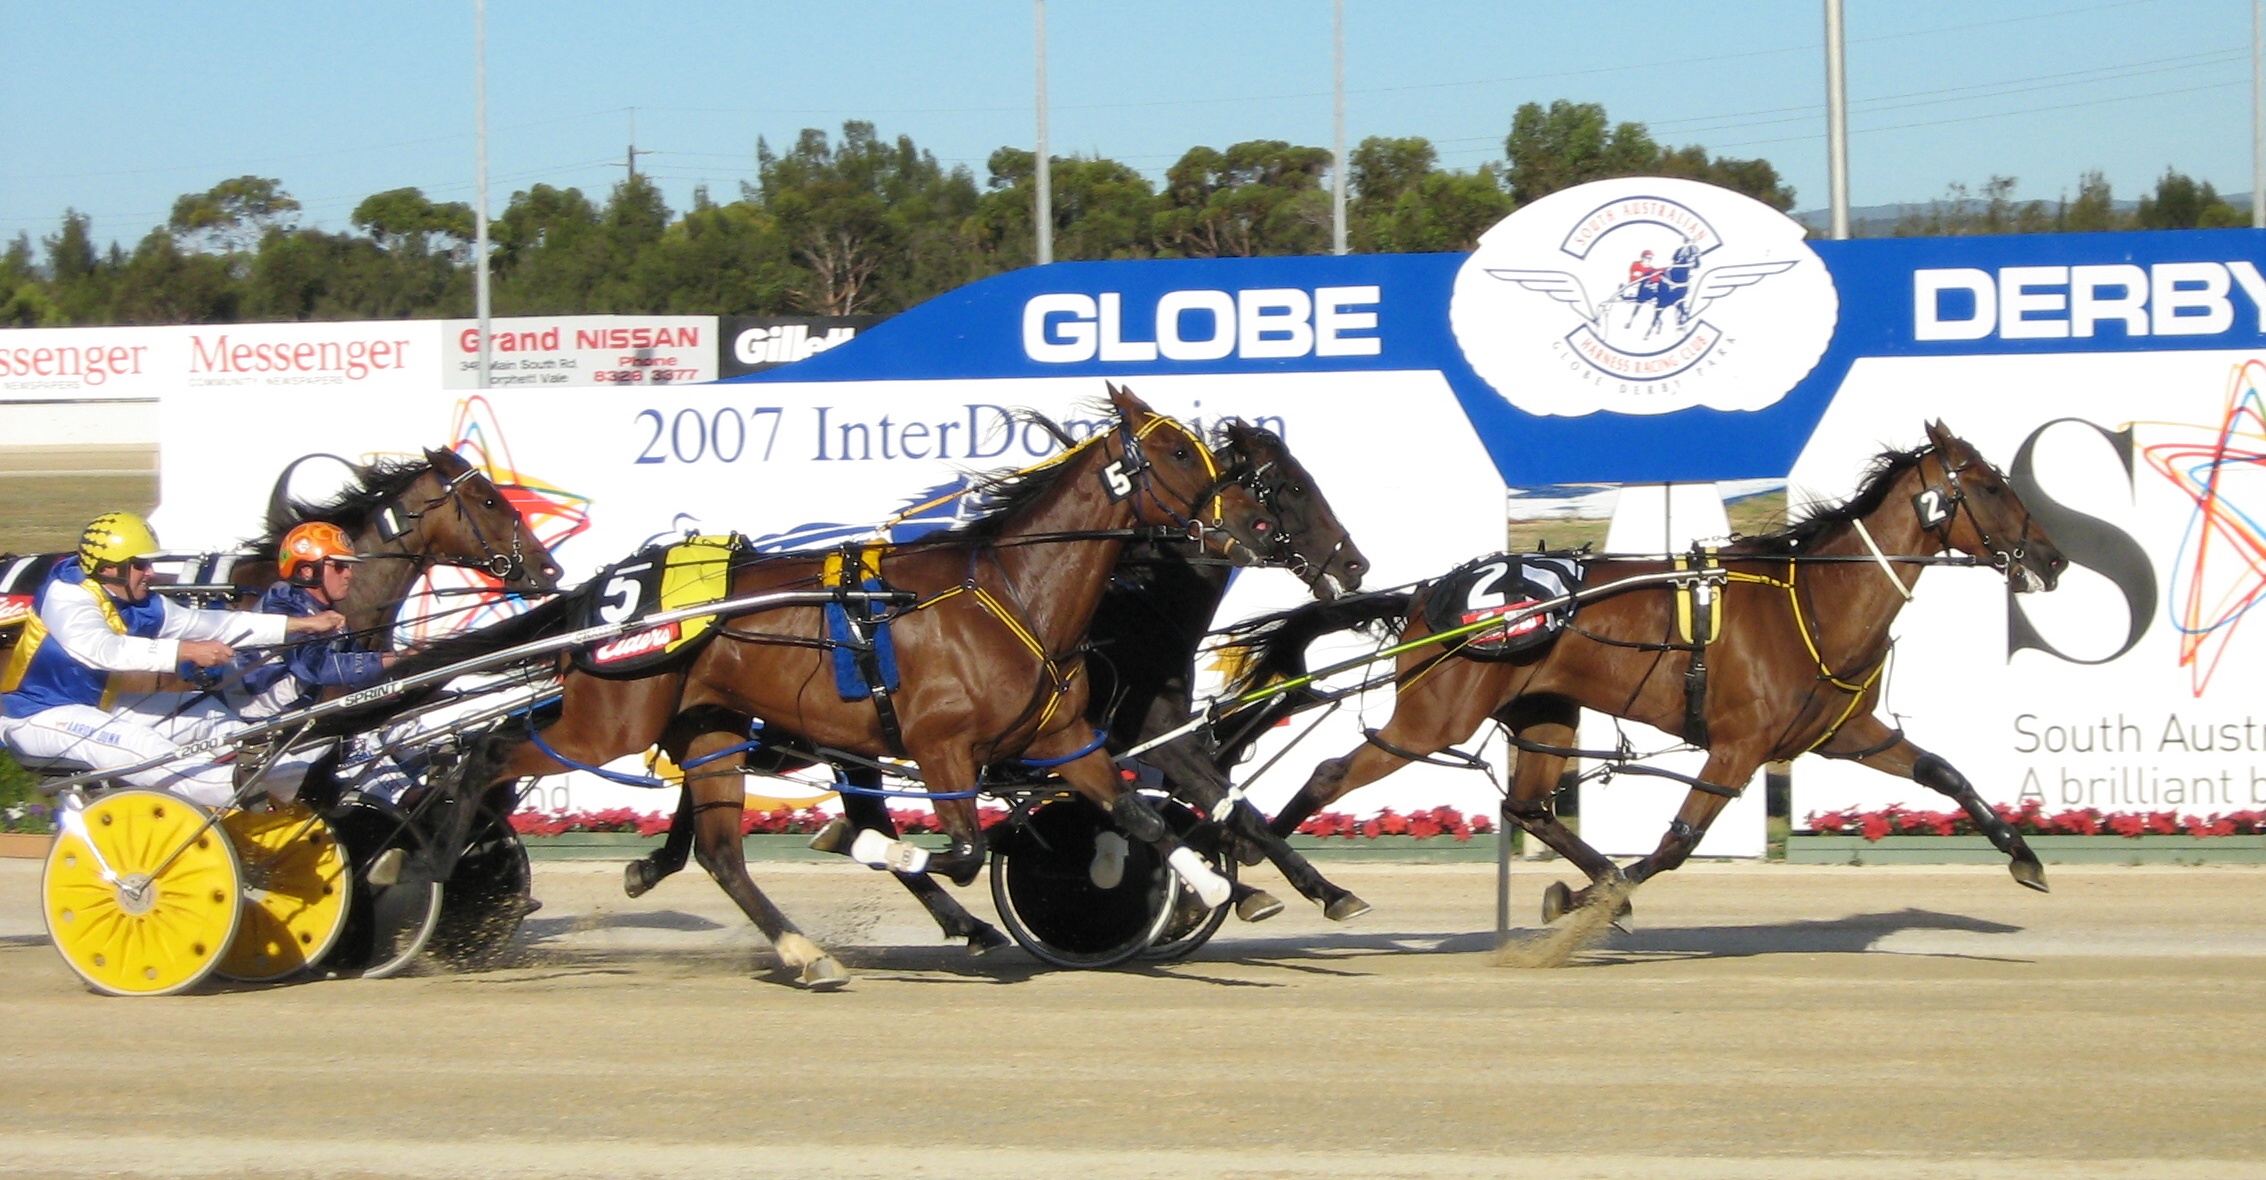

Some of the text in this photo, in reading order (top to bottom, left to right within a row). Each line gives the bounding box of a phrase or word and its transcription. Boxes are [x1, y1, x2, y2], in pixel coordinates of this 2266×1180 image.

[1574, 202, 1707, 246] SOUTH AUSTRALIAN
[460, 326, 699, 353] Grand NISSAN
[1022, 285, 1382, 364] GLOBE
[189, 334, 410, 381] Messenger
[618, 355, 678, 368] Phone
[735, 323, 857, 365] Gillet
[1580, 338, 1630, 373] HARNESS
[1679, 335, 1708, 360] CLUB
[266, 375, 345, 386] NEWSPAPERS
[490, 372, 569, 386] orphett Vale
[520, 359, 557, 370] South
[650, 368, 699, 382] 3377
[633, 399, 1287, 464] 2007 InterDomion
[1104, 460, 1132, 496] 5
[383, 507, 400, 535] 1
[1920, 490, 1947, 525] 2
[600, 562, 653, 624] 5
[1467, 562, 1509, 610] 2
[345, 682, 399, 707] SPRINT
[181, 738, 218, 757] 2000
[2014, 713, 2266, 753] South Aust
[2016, 767, 2047, 804] A
[2061, 766, 2233, 805] brilliant
